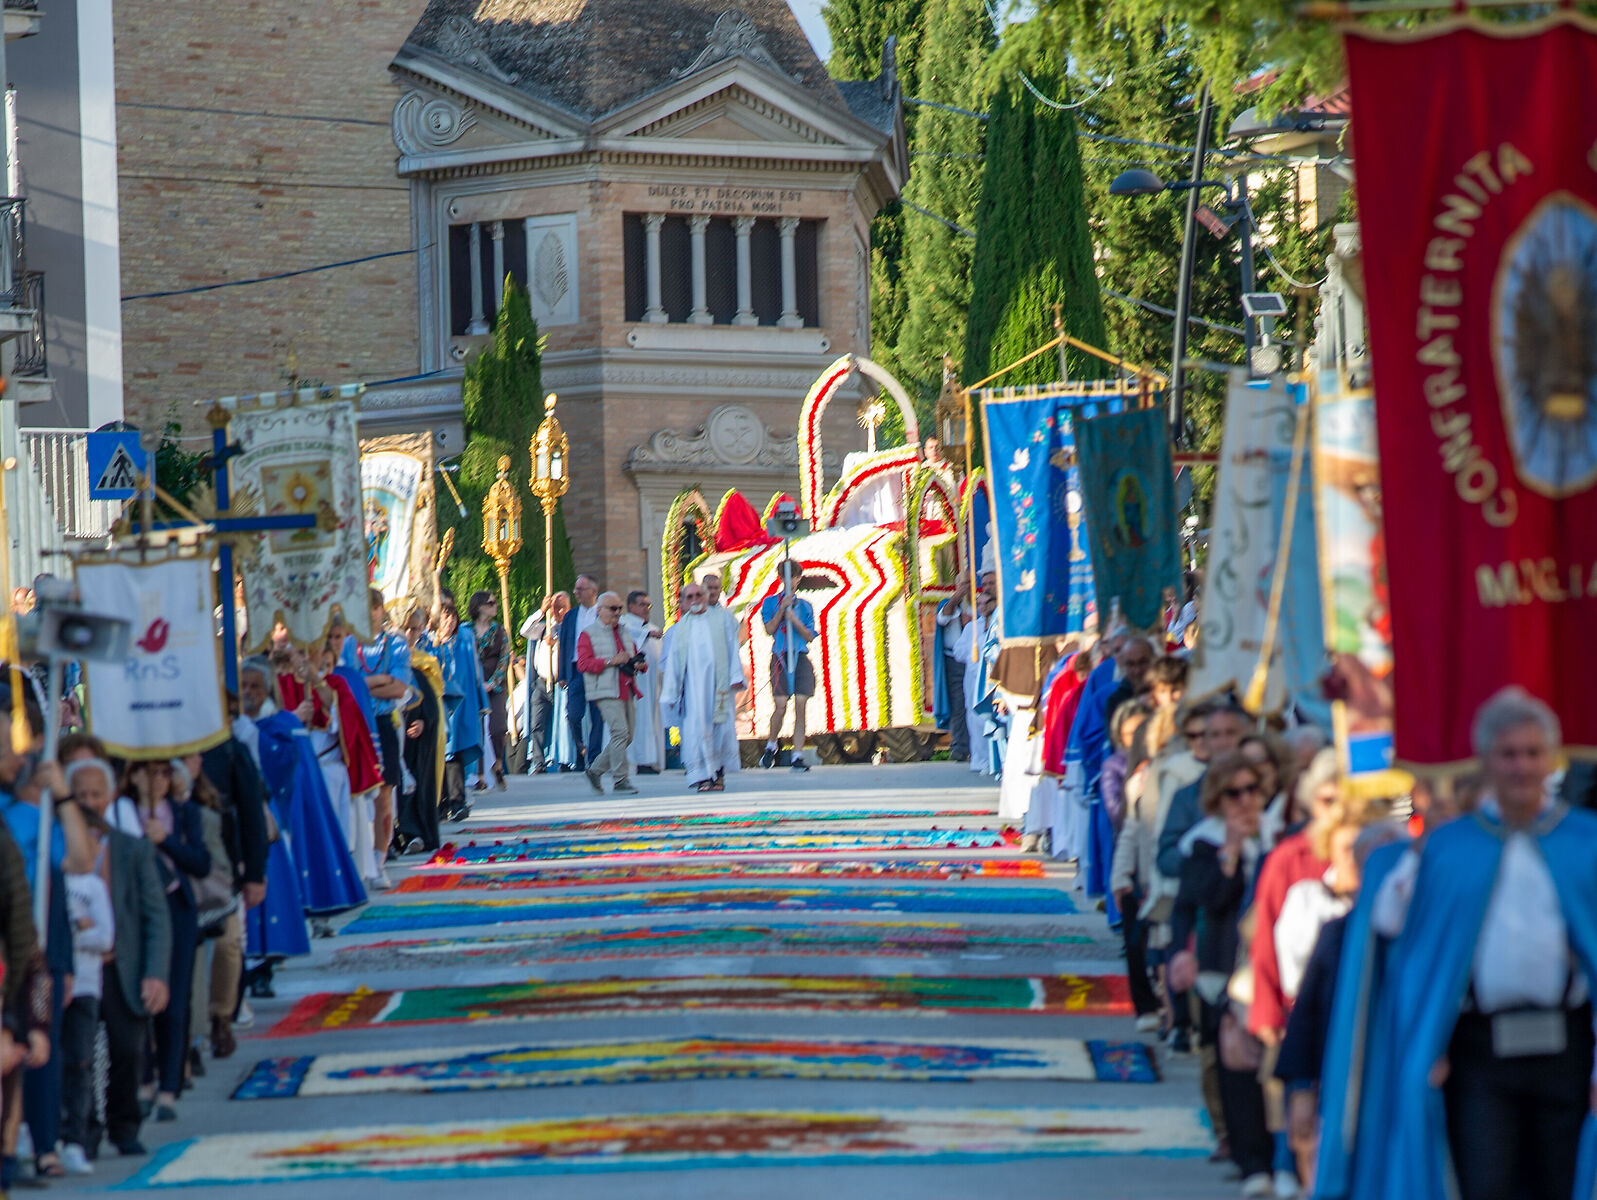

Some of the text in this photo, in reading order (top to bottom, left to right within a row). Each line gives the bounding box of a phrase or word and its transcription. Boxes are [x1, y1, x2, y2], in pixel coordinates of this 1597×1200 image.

[648, 186, 802, 201] DULCE ET DECORUM EST
[670, 199, 783, 212] PRO PATRIA MORI
[1416, 142, 1534, 527] CONFRATERNITA
[123, 654, 182, 681] RnS
